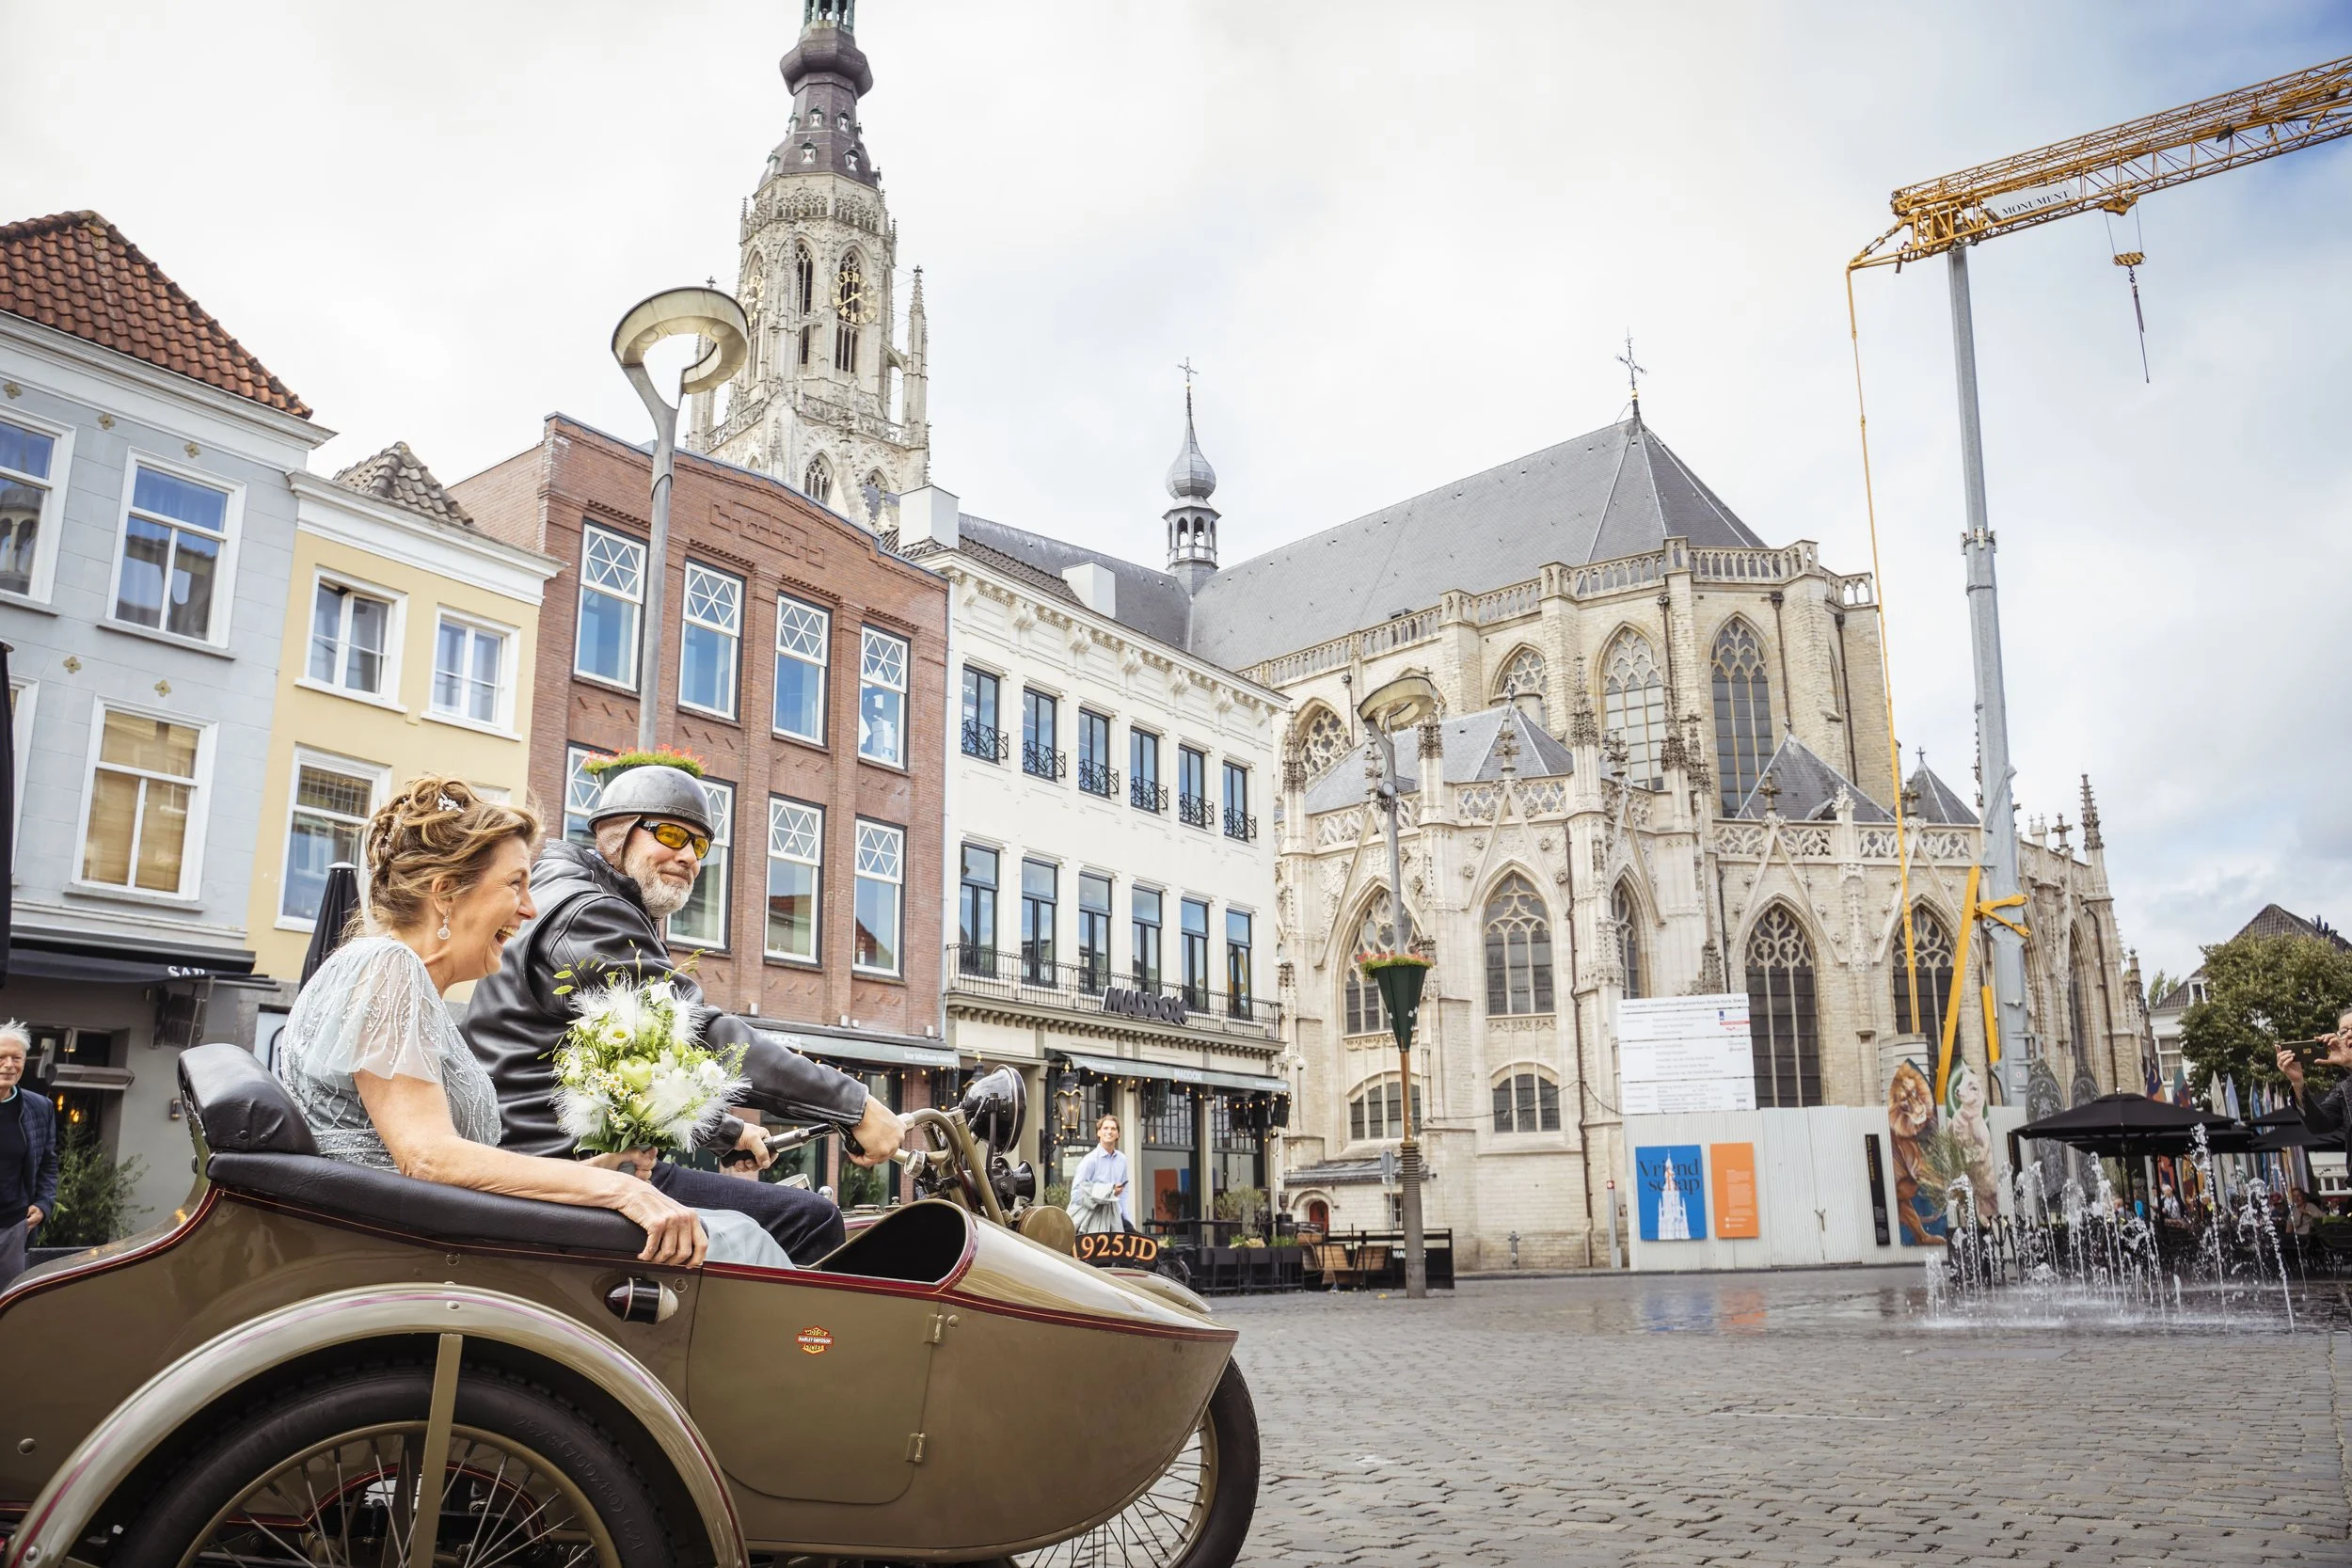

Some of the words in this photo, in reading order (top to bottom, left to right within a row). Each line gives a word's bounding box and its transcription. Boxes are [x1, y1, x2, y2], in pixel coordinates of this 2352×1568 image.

[2002, 191, 2069, 216] MONUMENT
[1102, 986, 1188, 1025] MADDOX
[1174, 1069, 1203, 1082] MADDOX
[805, 1343, 822, 1352] CYCLES
